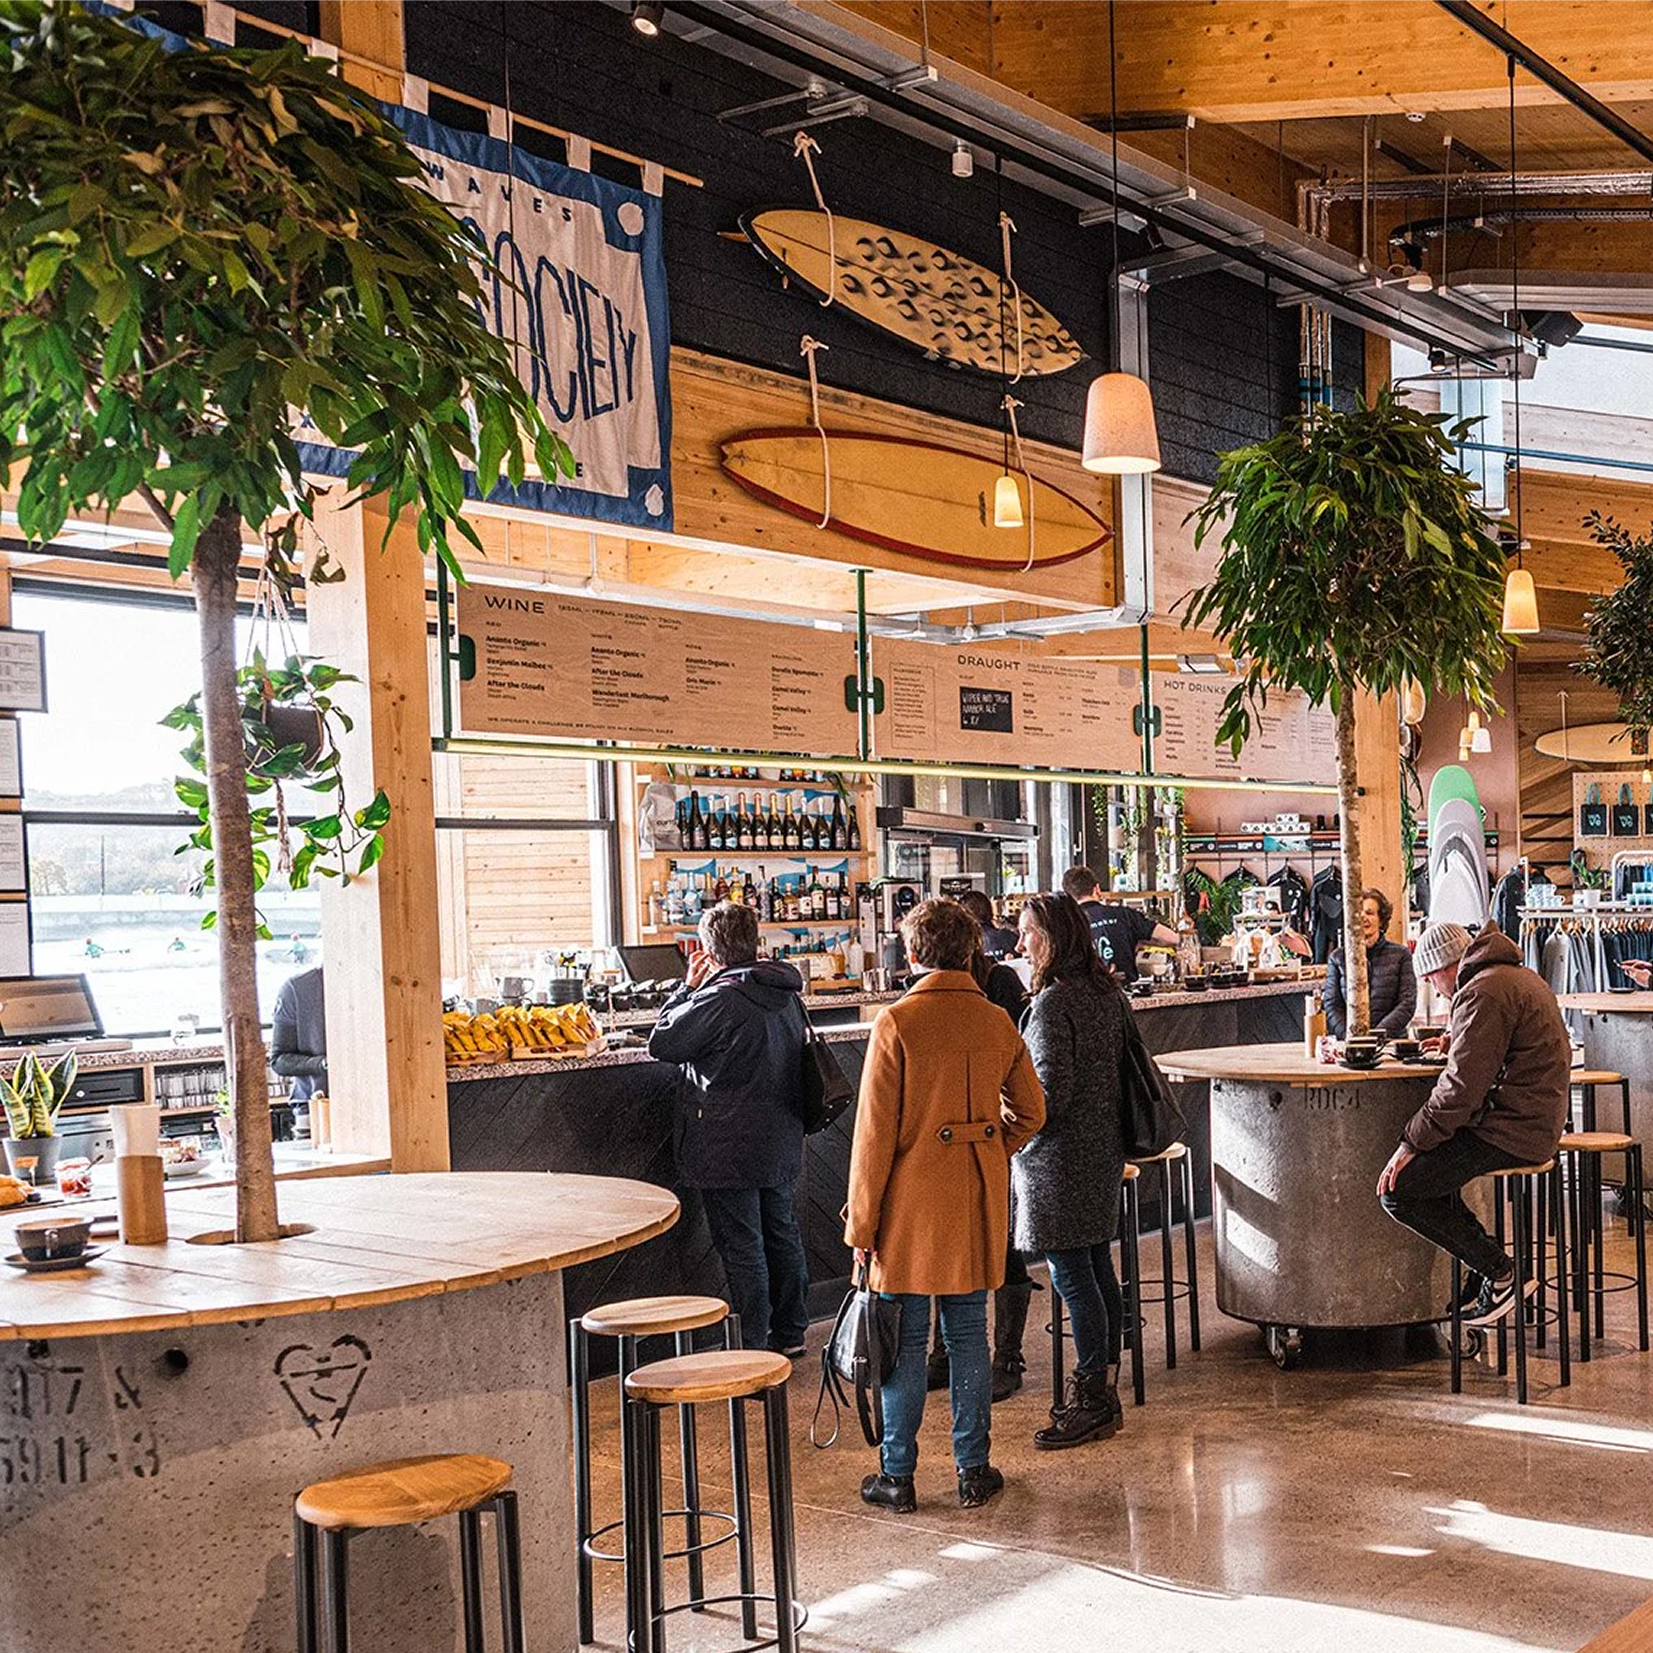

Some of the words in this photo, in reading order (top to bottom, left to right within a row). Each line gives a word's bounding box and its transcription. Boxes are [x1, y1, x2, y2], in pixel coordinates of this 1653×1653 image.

[426, 162, 571, 222] WAVES
[484, 595, 544, 614] WINE
[513, 638, 540, 647] Organic
[616, 649, 640, 658] Organic
[487, 658, 520, 667] Benjamin
[521, 661, 546, 669] Malbec
[958, 654, 1021, 670] DRAUGHT
[487, 680, 506, 688] After
[508, 681, 519, 689] the
[521, 683, 545, 691] Clouds
[1164, 681, 1185, 690] HOT
[1188, 683, 1227, 695] DRINKS
[630, 692, 670, 703] Marlborough
